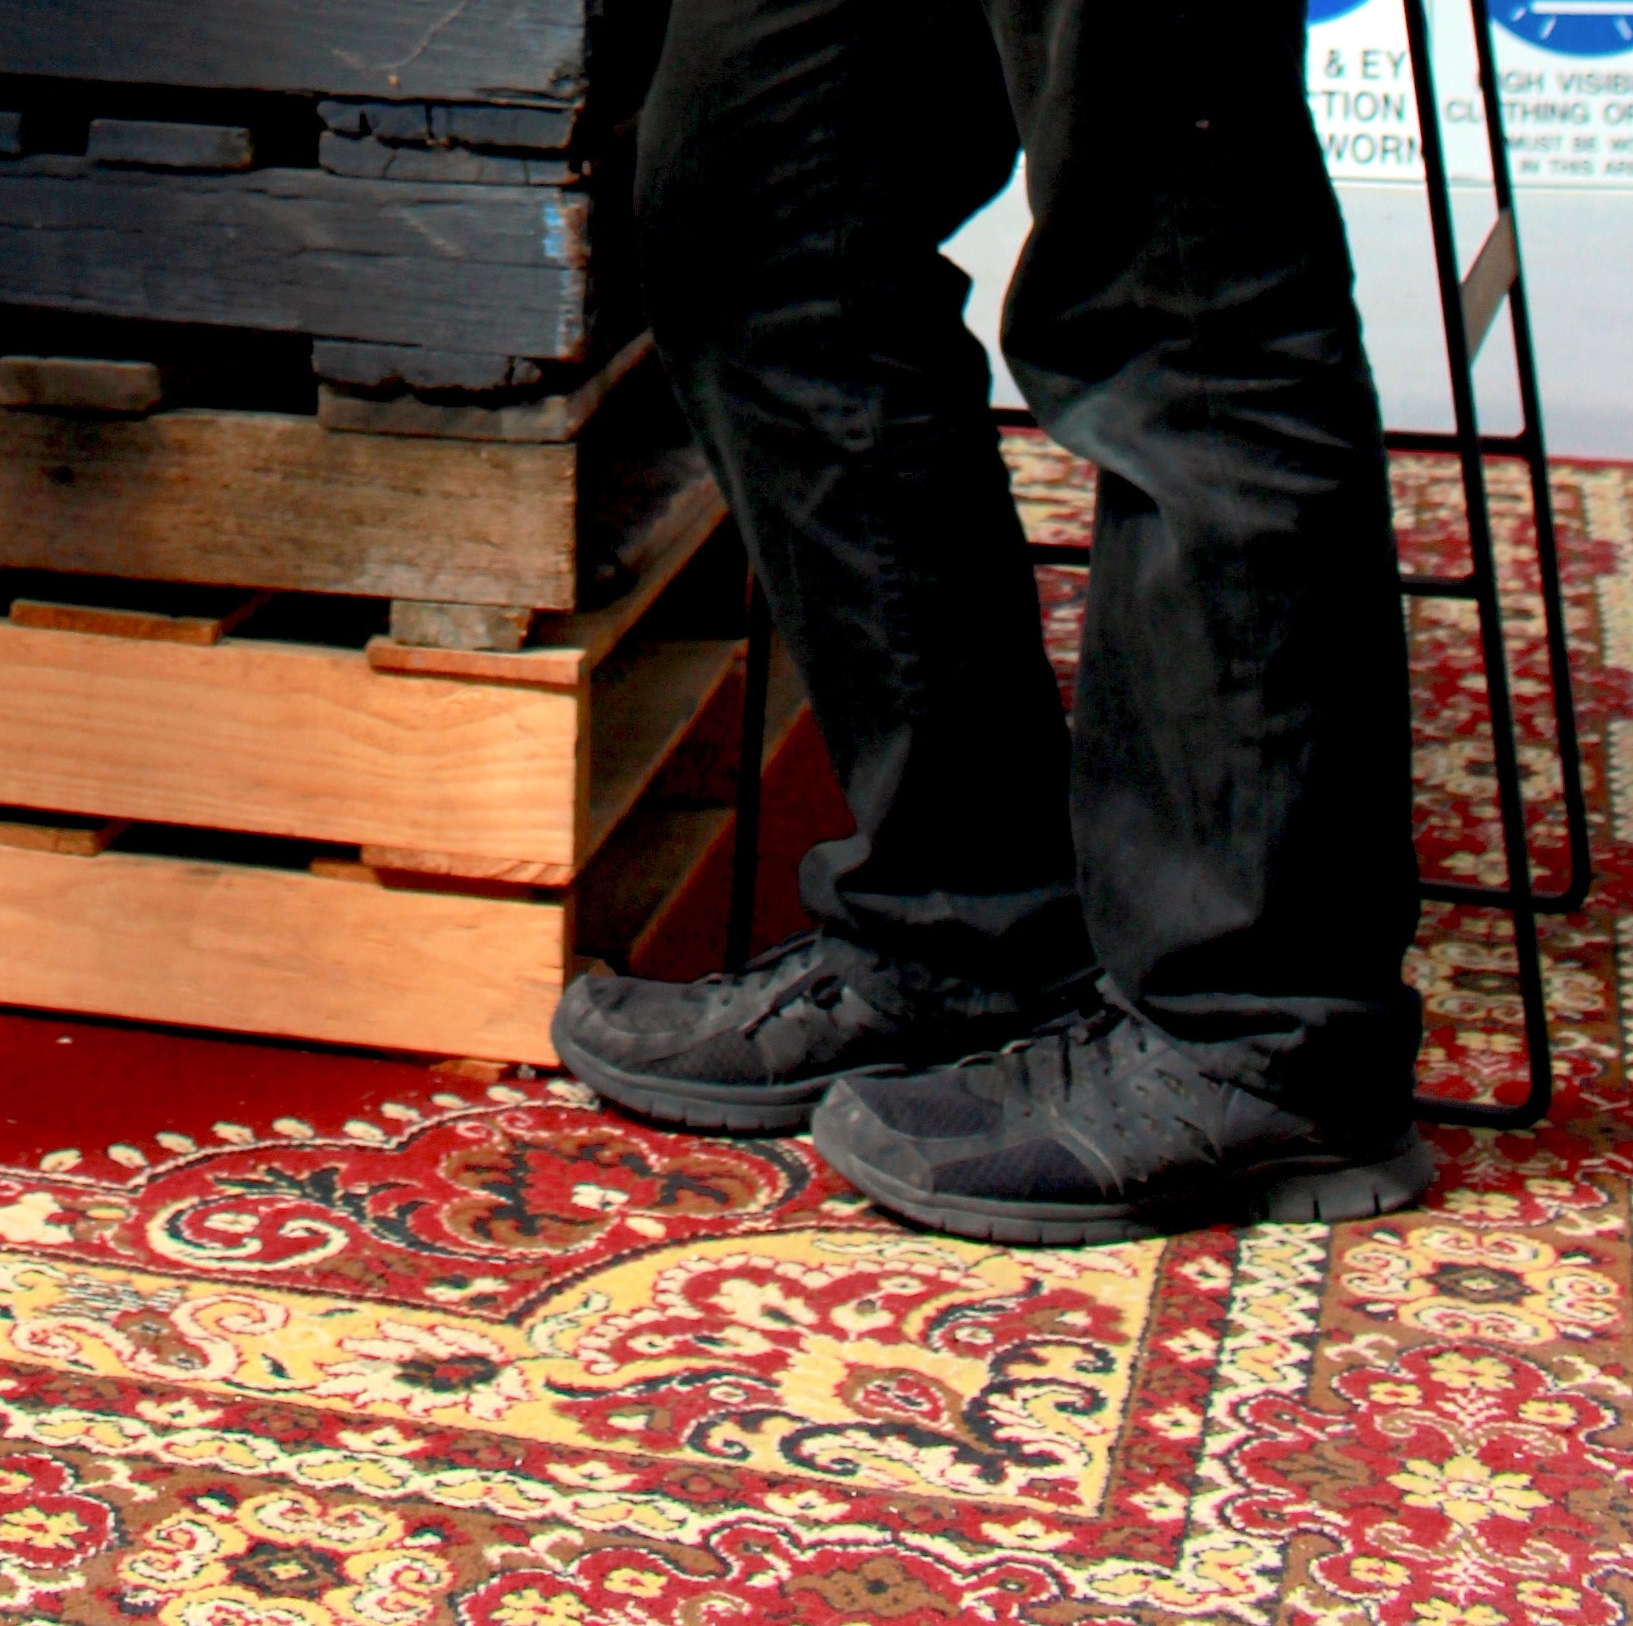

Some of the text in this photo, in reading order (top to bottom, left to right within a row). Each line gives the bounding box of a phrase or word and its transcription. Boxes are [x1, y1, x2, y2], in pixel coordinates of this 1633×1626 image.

[1323, 49, 1408, 80] & EY
[1308, 88, 1405, 122] TION
[1444, 96, 1590, 125] CLTHING
